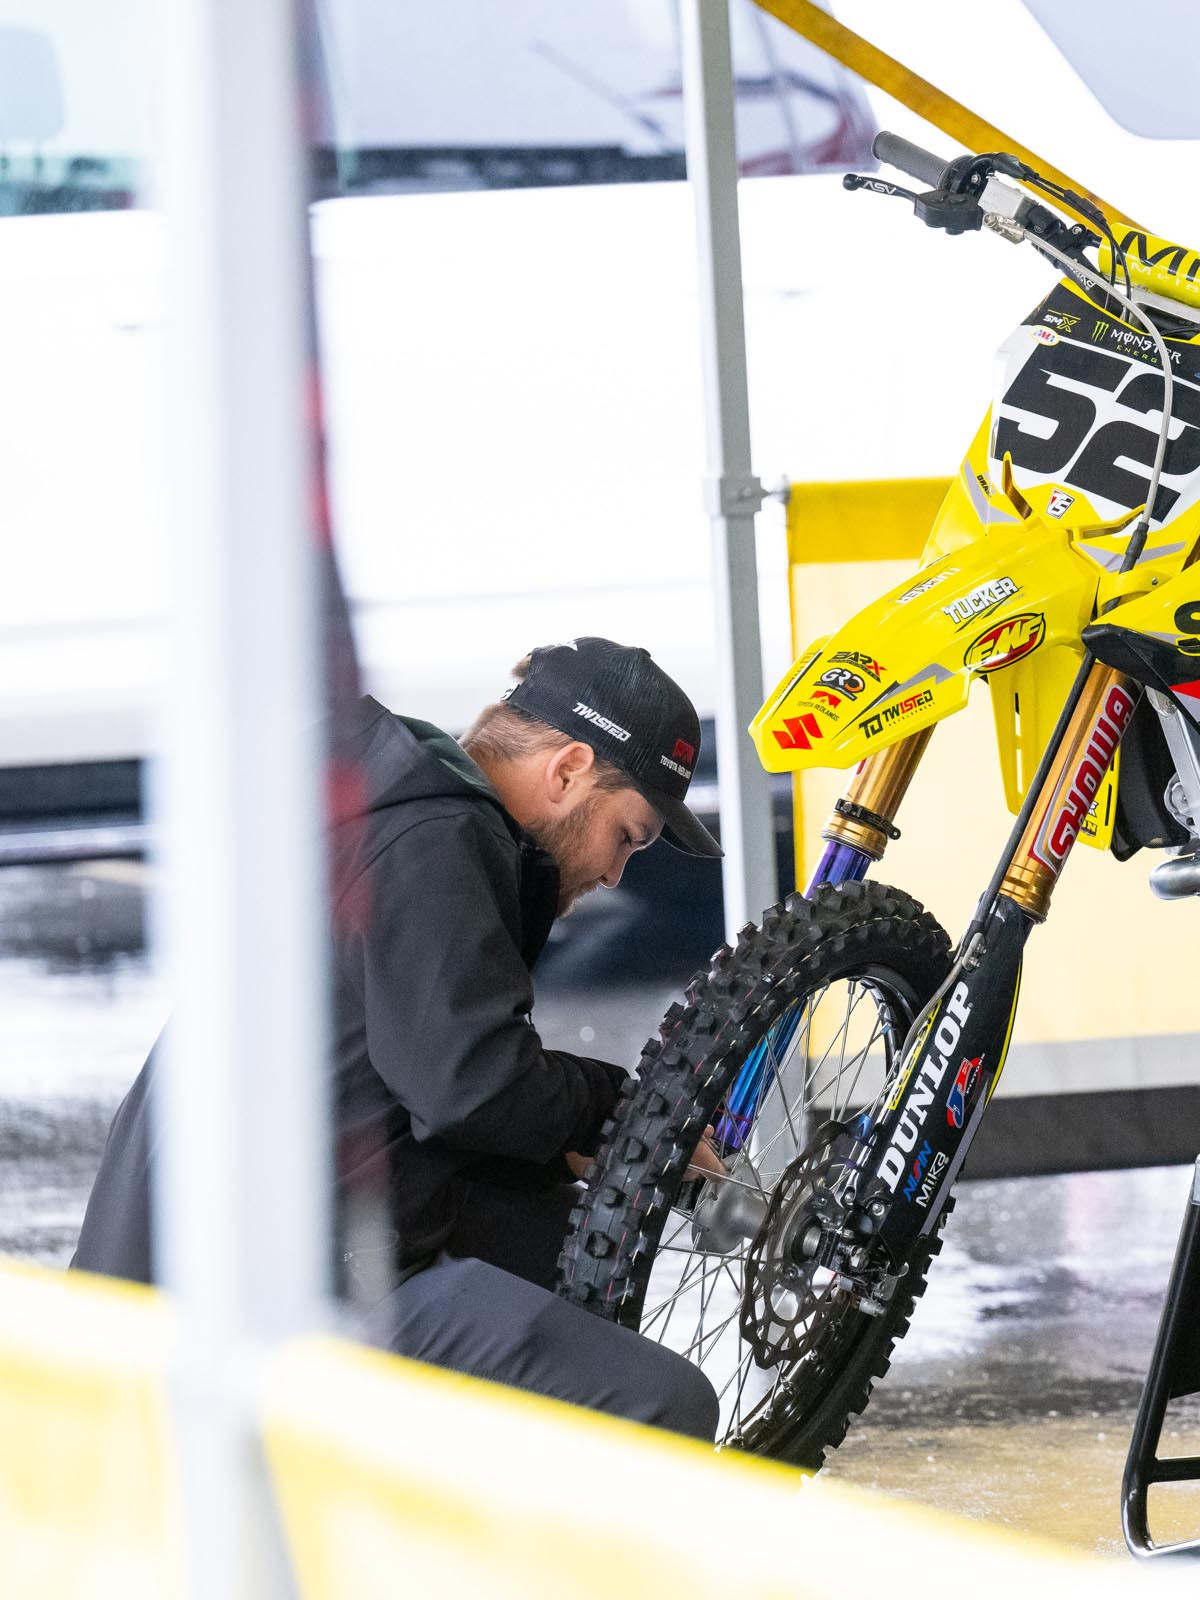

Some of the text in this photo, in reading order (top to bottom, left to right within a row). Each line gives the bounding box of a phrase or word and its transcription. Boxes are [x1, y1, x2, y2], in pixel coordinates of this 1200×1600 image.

[863, 180, 897, 196] ASV
[1116, 344, 1162, 366] ENERG
[941, 576, 1020, 625] TUCKER
[969, 614, 1043, 666] FMF
[572, 701, 632, 743] TWISTED
[881, 689, 934, 723] TWISTED
[877, 981, 970, 1195] DUNLOP
[916, 1152, 946, 1208] Mika
